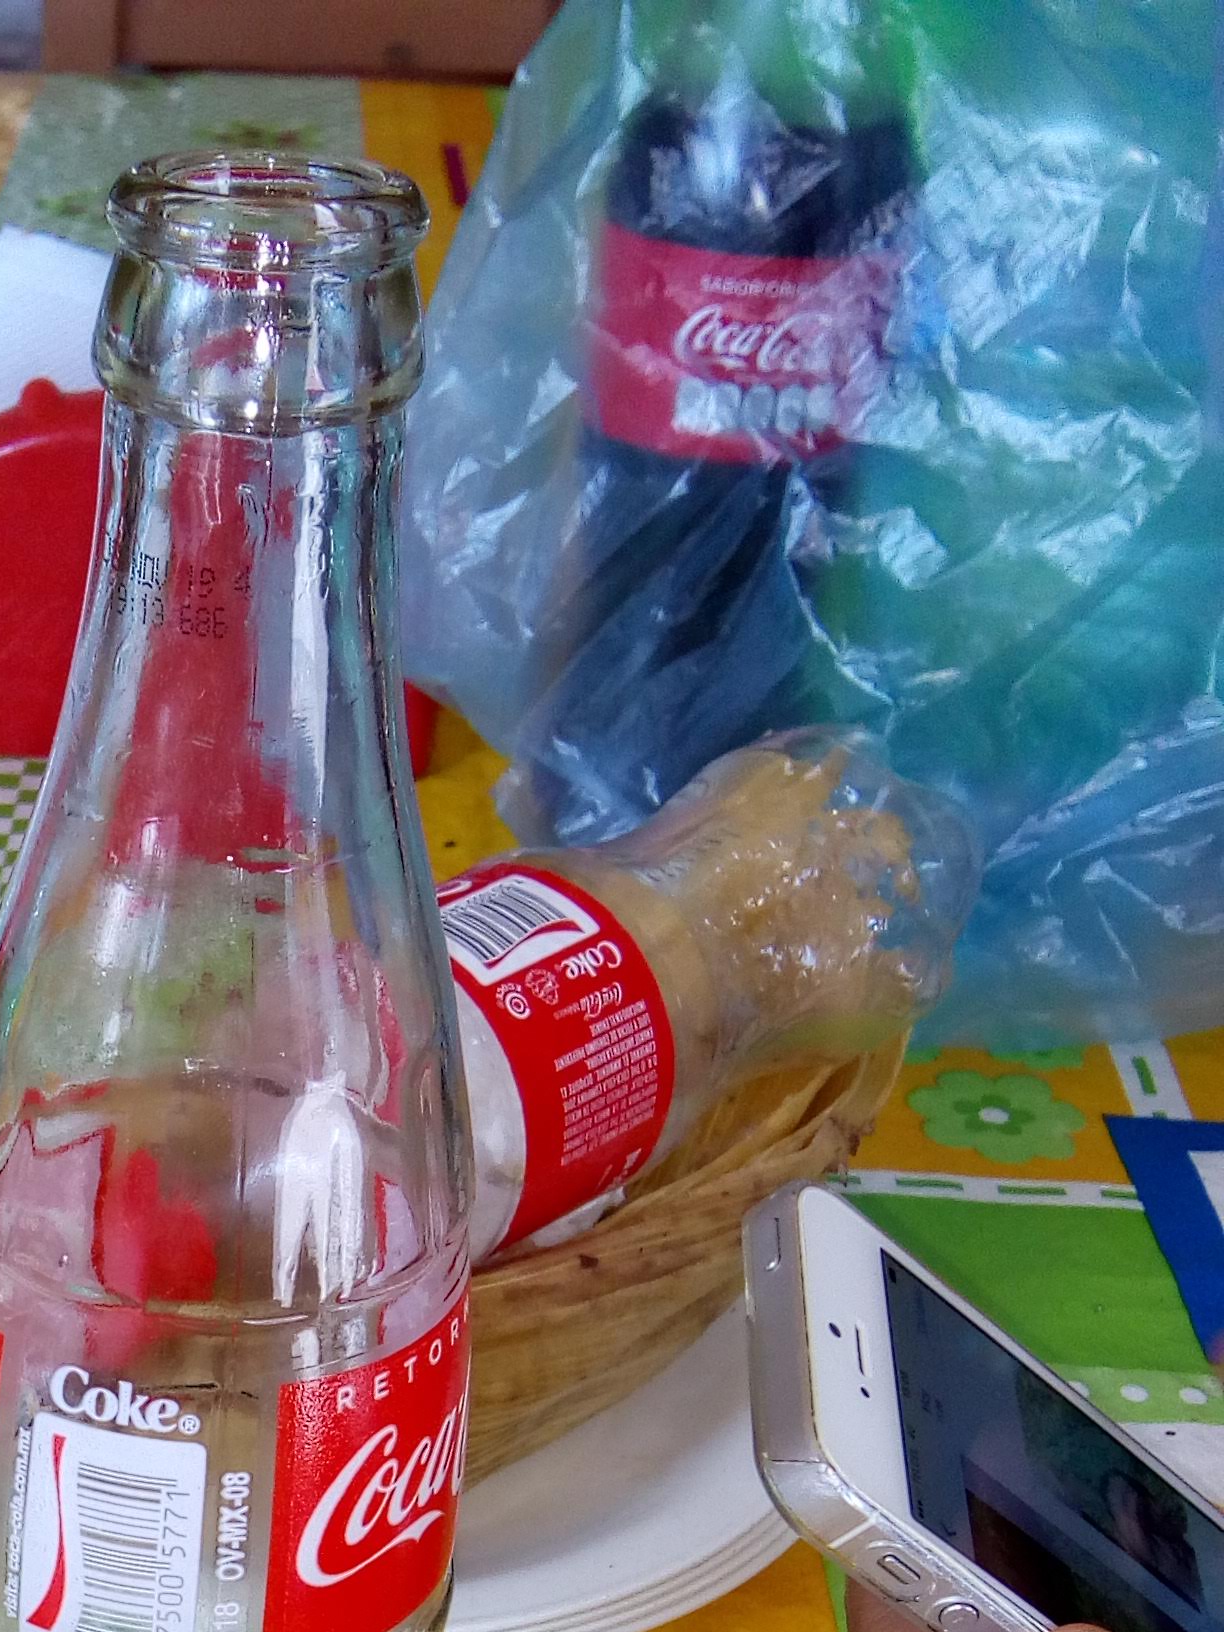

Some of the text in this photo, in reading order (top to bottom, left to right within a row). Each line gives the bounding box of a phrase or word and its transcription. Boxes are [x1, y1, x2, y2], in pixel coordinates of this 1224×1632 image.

[563, 940, 623, 981] Coke
[48, 1364, 181, 1435] Coke
[215, 1471, 252, 1582] OV-MX-08
[296, 1393, 469, 1588] Coca
